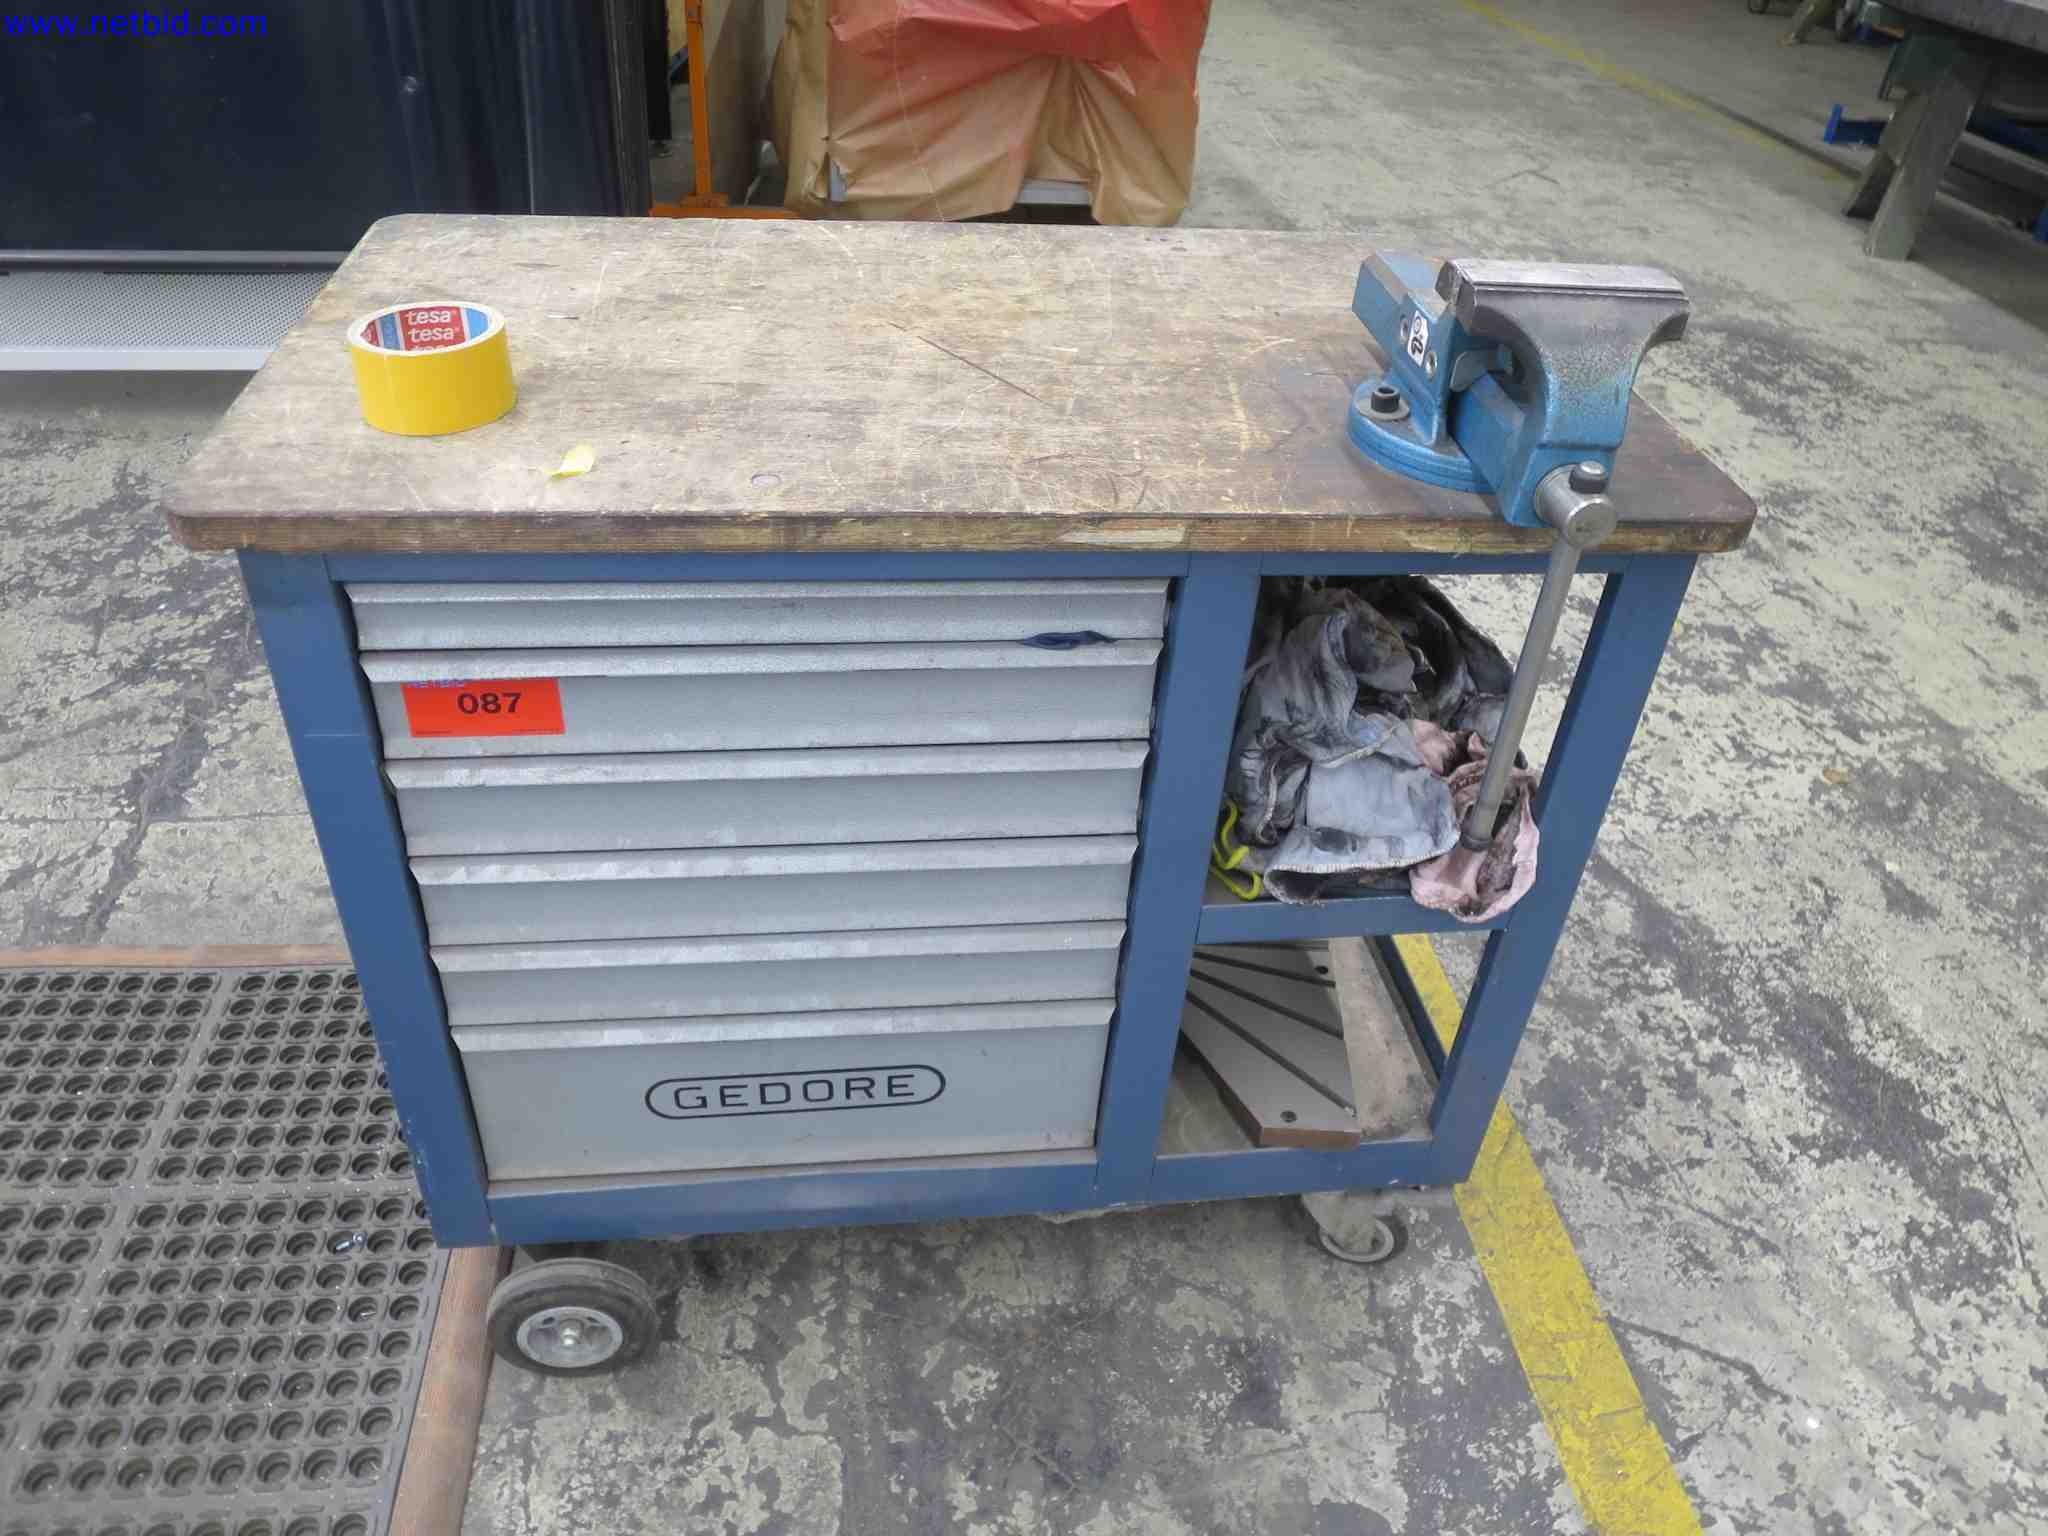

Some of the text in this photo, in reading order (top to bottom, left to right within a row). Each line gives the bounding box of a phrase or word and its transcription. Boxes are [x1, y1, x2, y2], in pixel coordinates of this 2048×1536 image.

[405, 309, 453, 326] tesa
[408, 327, 456, 342] tesa
[457, 692, 521, 714] 087
[673, 1074, 916, 1110] GEDORE
